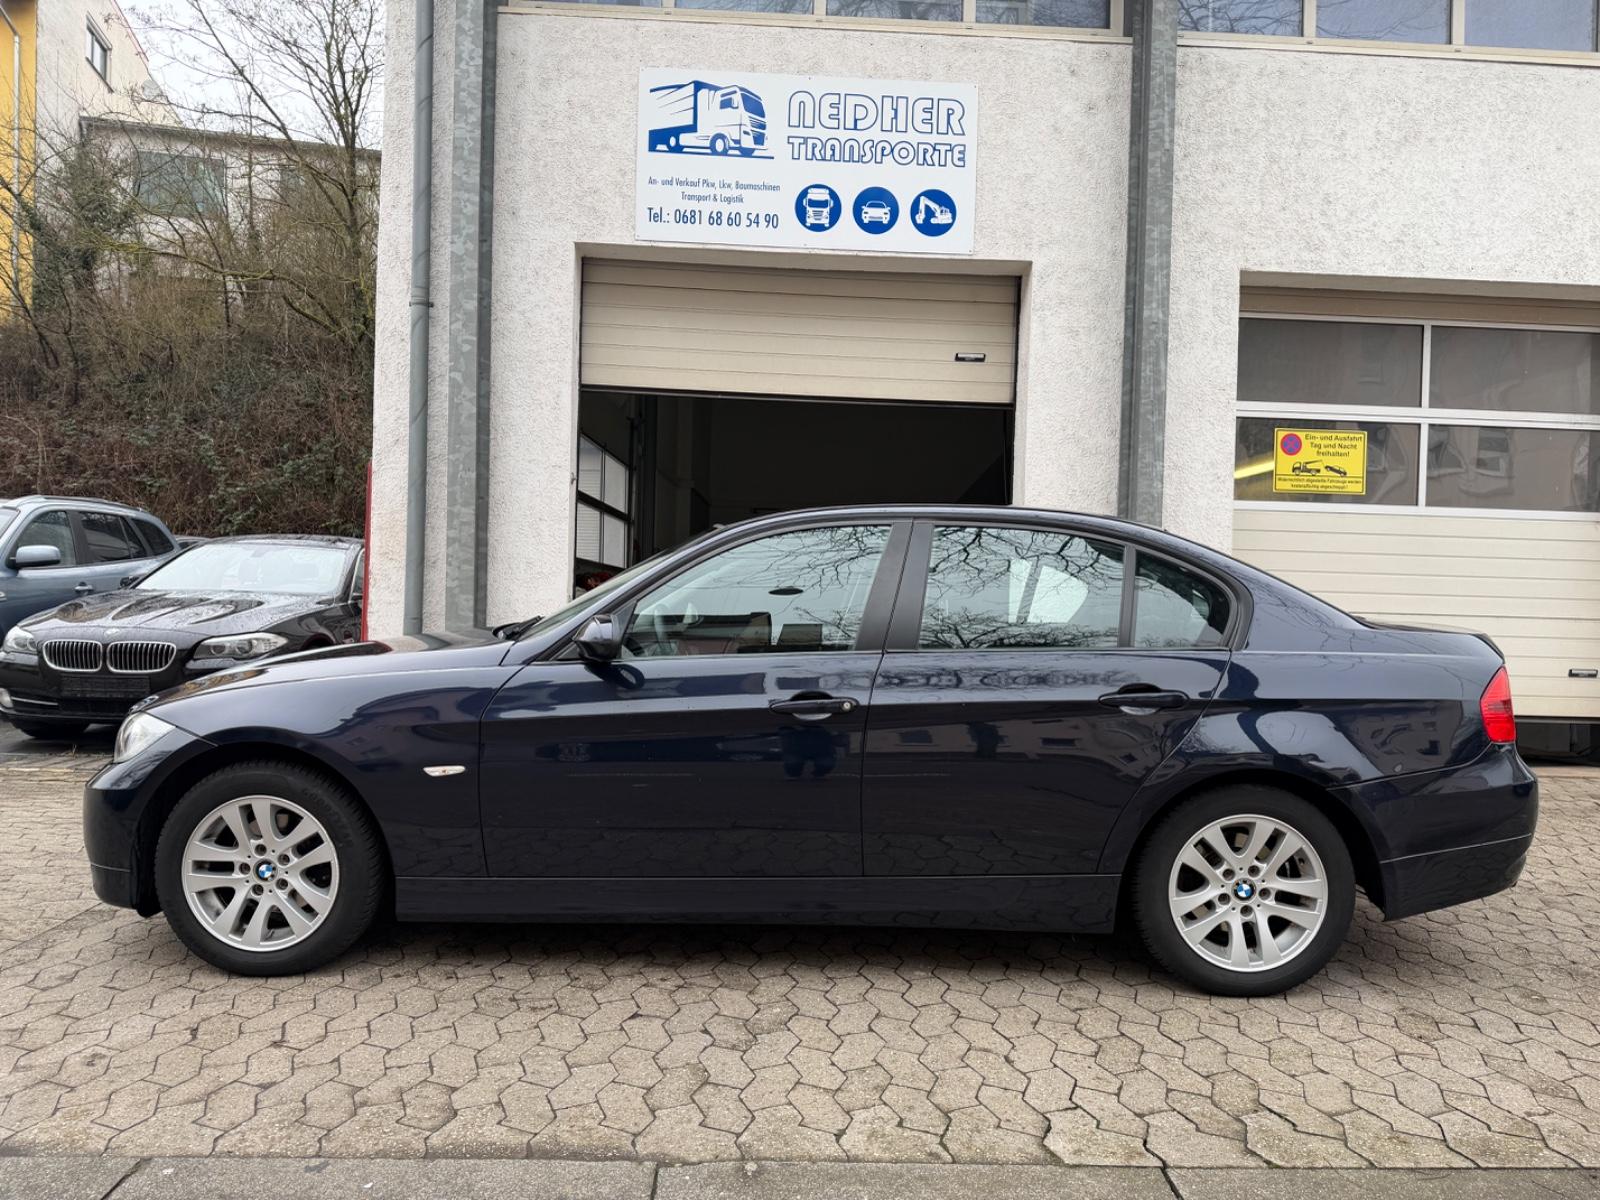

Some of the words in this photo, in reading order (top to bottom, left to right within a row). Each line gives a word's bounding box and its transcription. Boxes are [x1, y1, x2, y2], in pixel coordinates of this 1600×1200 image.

[788, 90, 966, 136] NEDHER
[787, 136, 967, 167] TRANSPORTE
[648, 176, 659, 185] An-
[661, 177, 673, 186] und
[675, 178, 700, 188] Verkauf
[702, 179, 716, 190] Pkw,
[719, 180, 732, 190] Lkw,
[735, 181, 781, 192] Baumaschinen
[681, 191, 711, 203] Transport
[713, 194, 718, 202] &
[720, 194, 744, 205] Logistik
[647, 206, 670, 223] Tel.:
[674, 209, 702, 225] 0681
[708, 211, 722, 226] 68
[727, 212, 741, 227] 60
[746, 213, 760, 228] 54
[764, 213, 779, 229] 90
